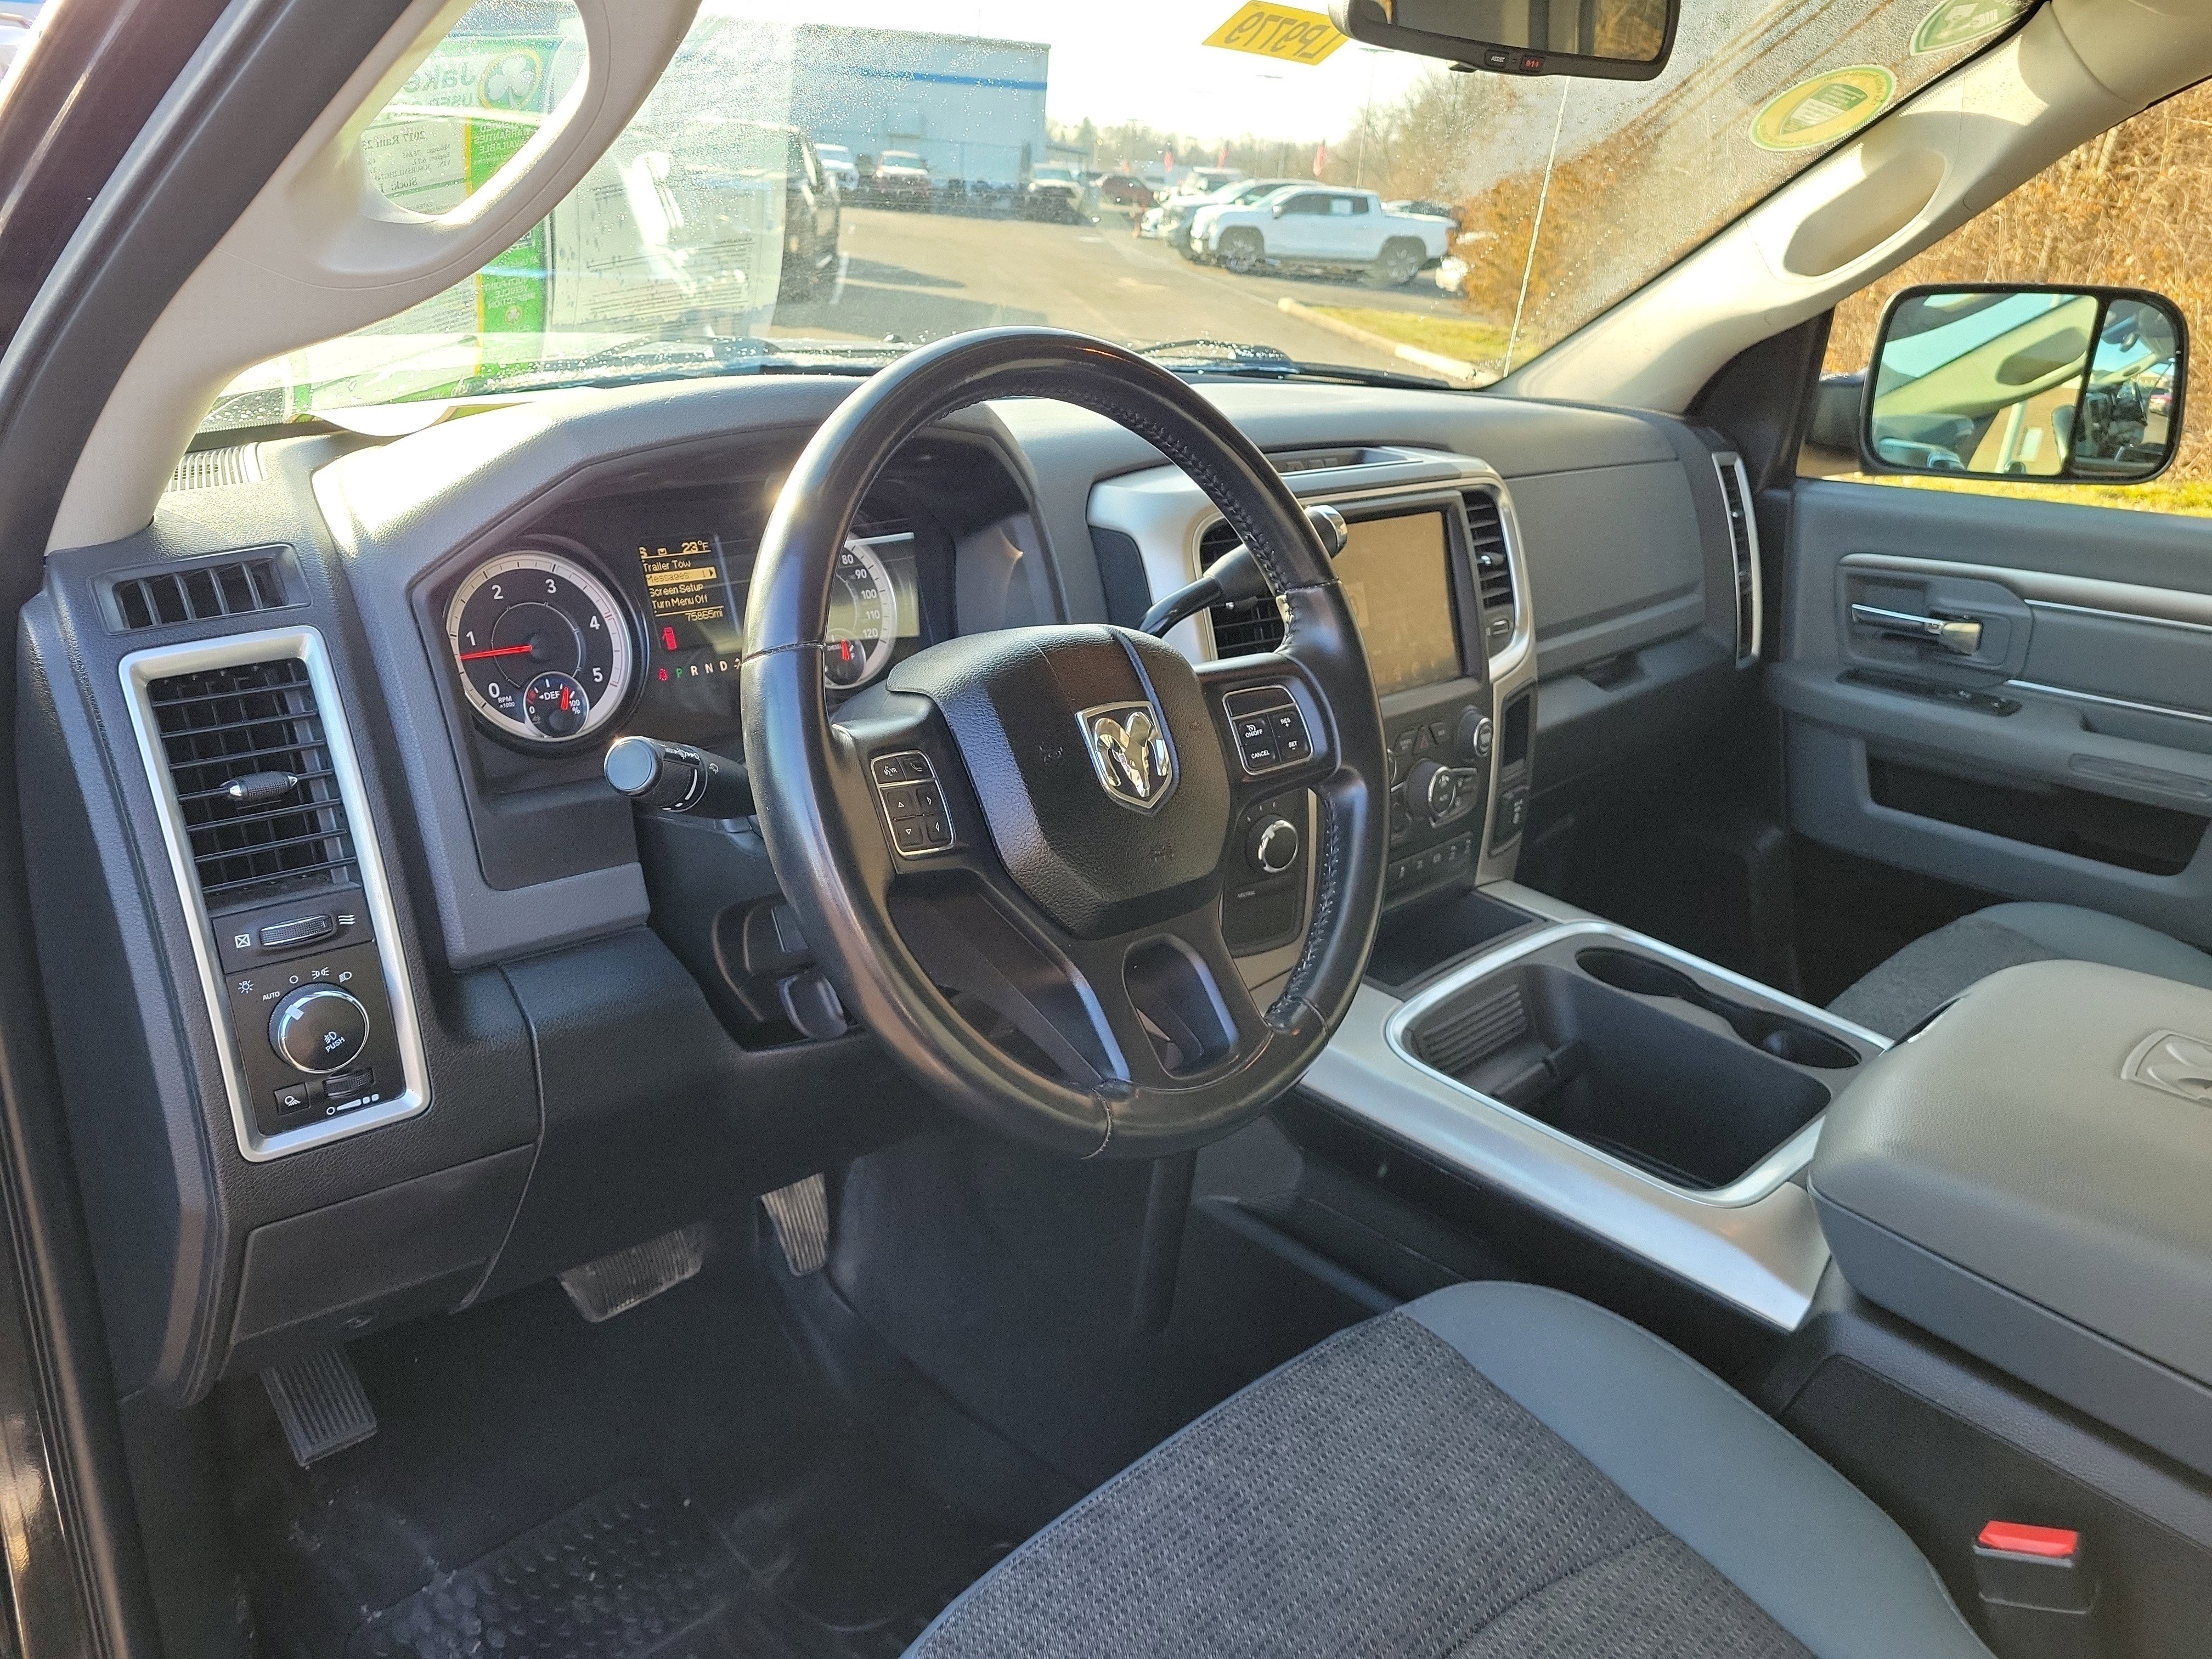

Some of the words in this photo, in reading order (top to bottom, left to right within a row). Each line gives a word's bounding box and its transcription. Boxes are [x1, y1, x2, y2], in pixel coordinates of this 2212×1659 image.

[842, 554, 854, 565] 80
[643, 562, 670, 573] Trailer
[671, 560, 691, 568] Tow
[647, 572, 690, 583] Messages
[855, 569, 867, 579] 90
[545, 579, 556, 594] 3
[648, 586, 679, 597] Screen
[679, 583, 704, 594] Setup
[492, 585, 504, 600] 2
[861, 589, 877, 600] 100
[652, 600, 671, 610] Turn
[670, 597, 695, 607] Menu
[695, 594, 708, 603] Off
[866, 610, 880, 620] 110
[590, 616, 600, 630] 4
[466, 631, 476, 646] 1
[862, 628, 878, 639] 120
[592, 668, 603, 682] 5
[675, 668, 682, 679] P
[690, 665, 698, 676] R
[704, 663, 713, 674] N
[719, 661, 727, 672] D
[488, 682, 500, 698] 0
[498, 696, 512, 704] RPM
[544, 691, 560, 701] DEF
[529, 706, 535, 714] 0
[1245, 729, 1263, 738] ON/OFF
[1251, 749, 1270, 759] CANCEL
[262, 991, 280, 1001] AUTO
[325, 1036, 346, 1052] PUSH
